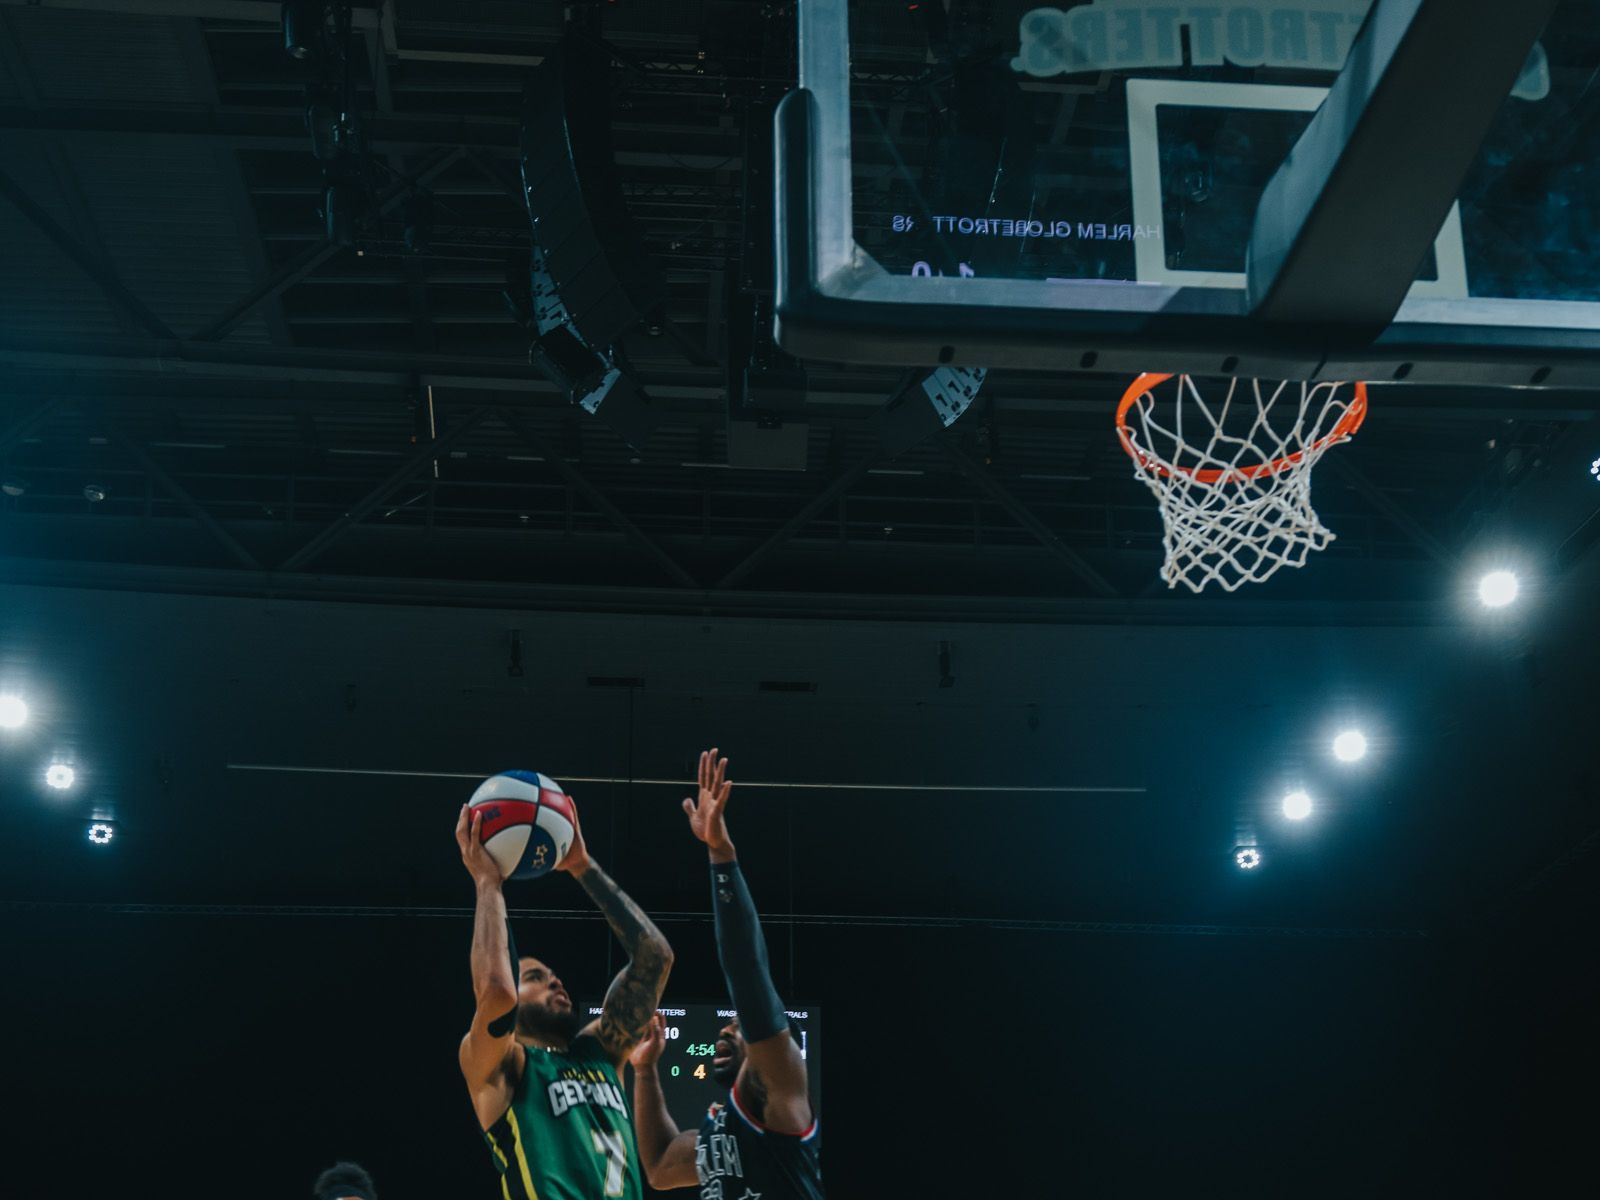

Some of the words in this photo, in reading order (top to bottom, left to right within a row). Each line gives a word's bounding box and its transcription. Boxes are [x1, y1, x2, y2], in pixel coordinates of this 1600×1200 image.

[686, 1044, 716, 1056] 4:54
[671, 1065, 679, 1077] 0
[693, 1063, 706, 1080] 4
[590, 1129, 627, 1198] 7
